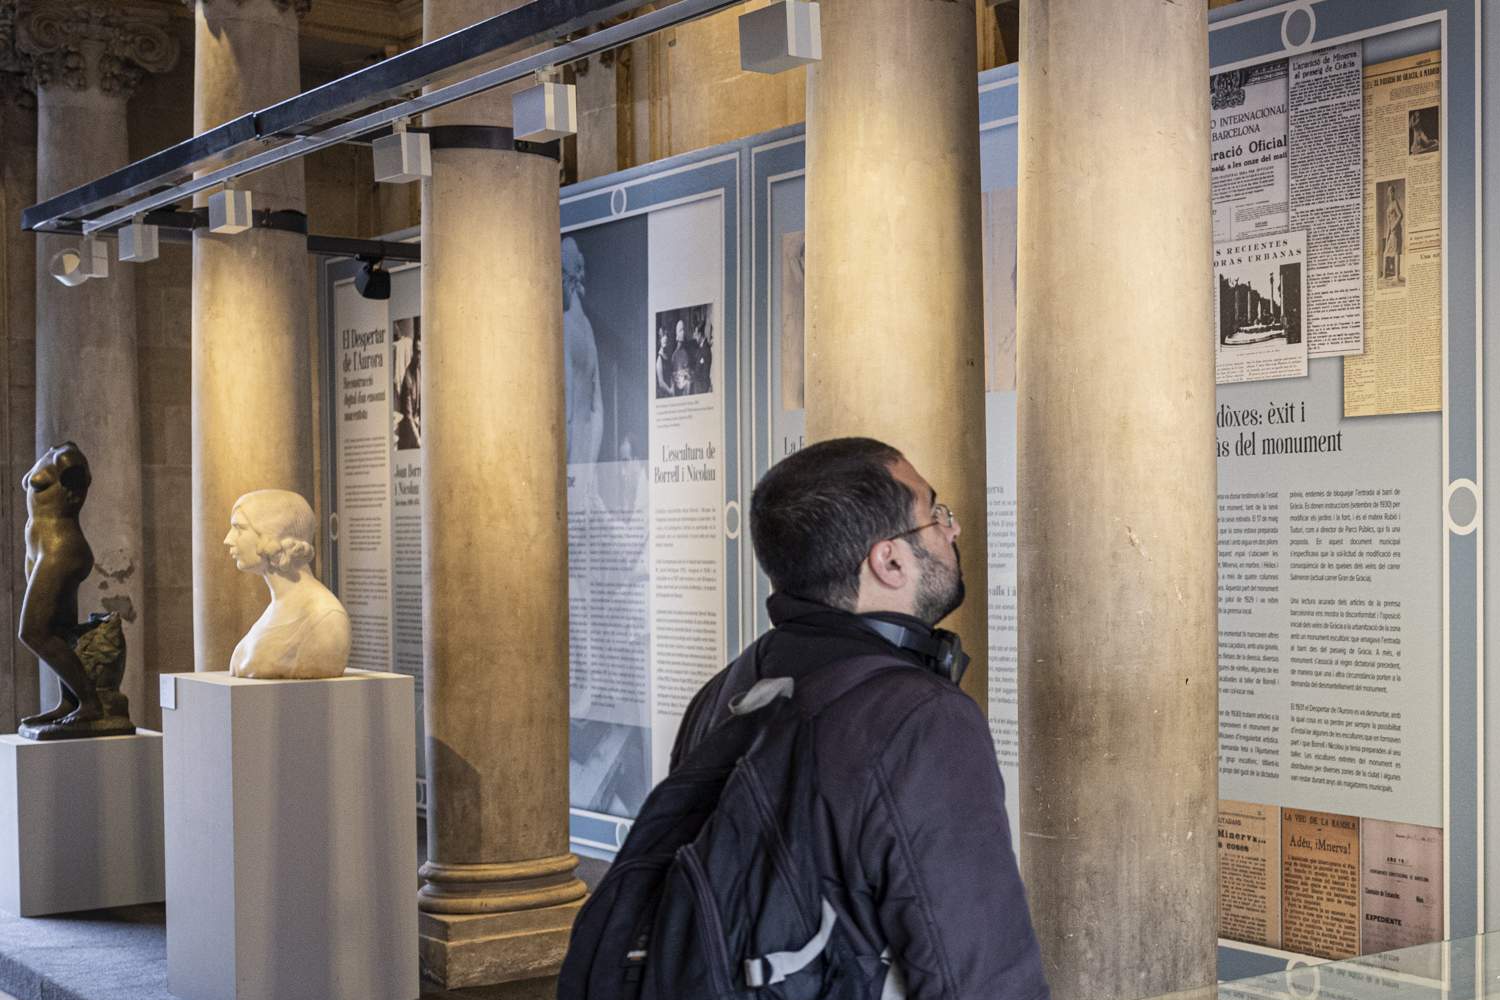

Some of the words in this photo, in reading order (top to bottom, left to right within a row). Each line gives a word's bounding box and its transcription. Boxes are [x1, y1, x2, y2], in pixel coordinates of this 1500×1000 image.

[1220, 104, 1287, 128] INTERNACIONAL
[1212, 123, 1260, 142] BARCELONA
[1211, 145, 1243, 161] ració
[1249, 135, 1287, 153] Oficial
[1261, 154, 1271, 163] del
[1226, 240, 1288, 255] RECIENTES
[1248, 248, 1302, 263] URBANAS
[1267, 401, 1296, 425] èxit
[1300, 400, 1307, 424] i
[706, 441, 716, 459] de
[1234, 430, 1256, 457] del
[1261, 429, 1344, 456] monument
[654, 464, 680, 484] Borrell
[687, 463, 716, 482] Nicolau
[1365, 913, 1403, 927] EXPEDIENTE
